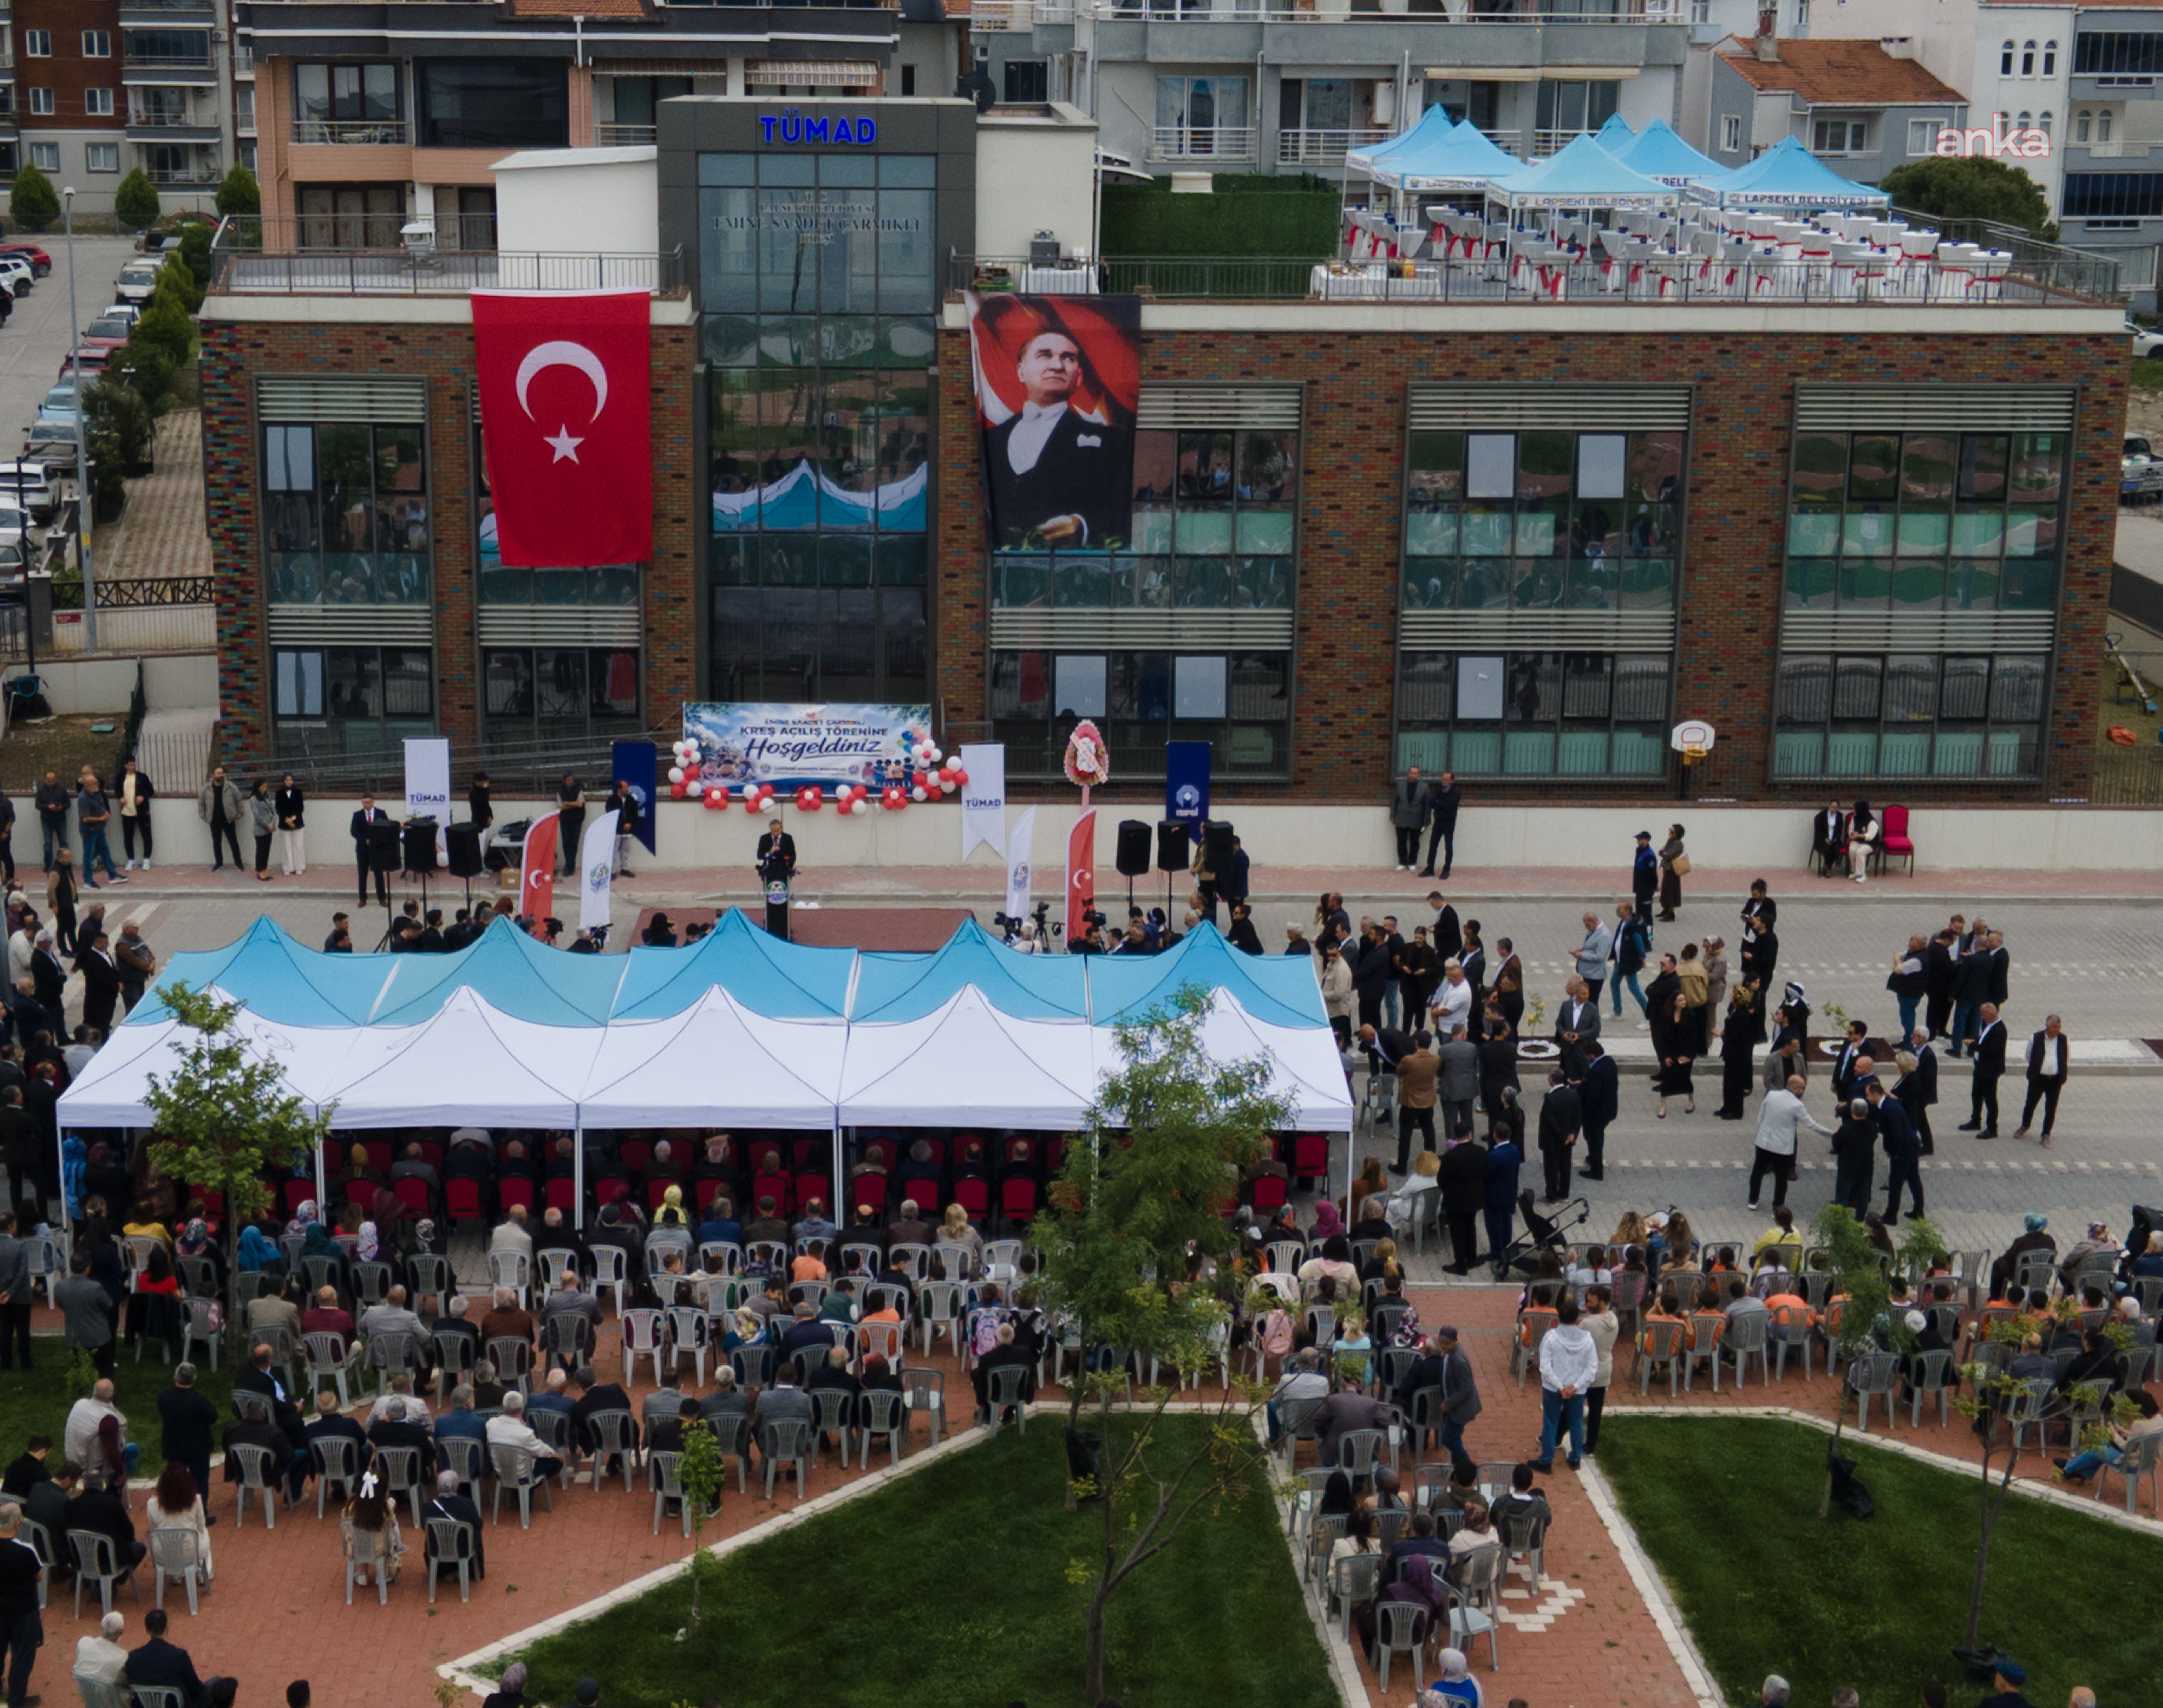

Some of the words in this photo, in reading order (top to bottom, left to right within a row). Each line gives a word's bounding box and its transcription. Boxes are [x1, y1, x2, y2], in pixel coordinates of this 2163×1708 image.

[759, 108, 877, 144] TÜMAD
[1744, 194, 1795, 205] LAPSEKİ
[740, 726, 775, 738] KREŞ
[780, 726, 822, 738] AÇILIŞ
[826, 726, 888, 736] TÖRENİNE
[744, 737, 882, 762] Hoşgeldiniz
[409, 793, 446, 802] TÜMAD
[966, 798, 1001, 807] TÜMAD
